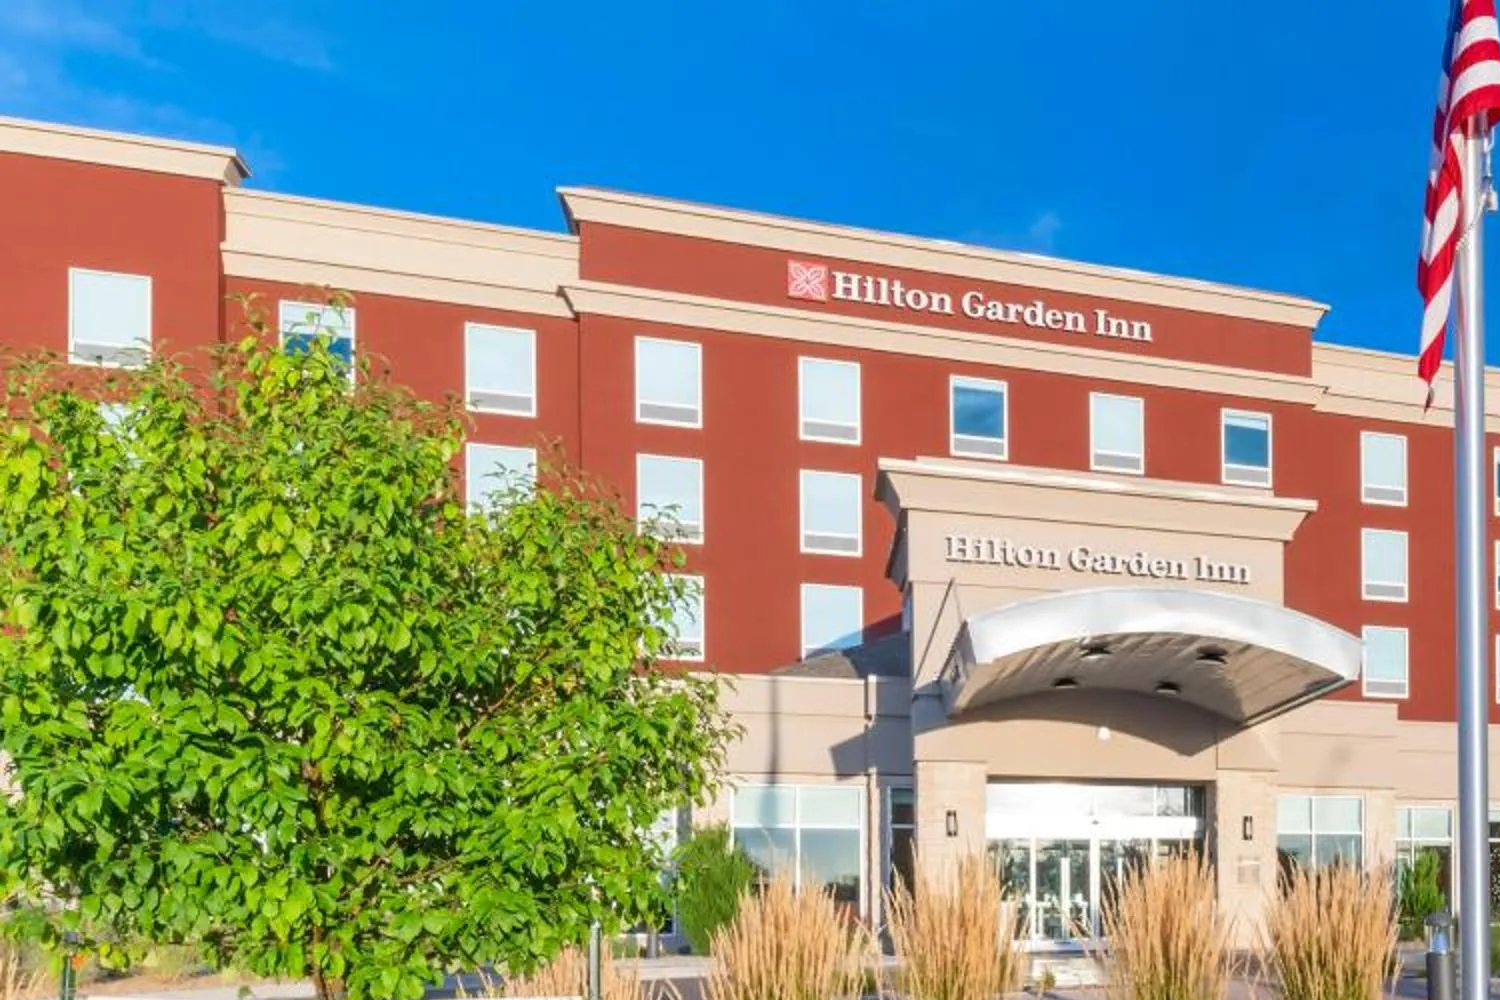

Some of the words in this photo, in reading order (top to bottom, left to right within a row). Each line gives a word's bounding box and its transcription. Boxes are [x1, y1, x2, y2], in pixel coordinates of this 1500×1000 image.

[831, 272, 953, 314] Hilton
[961, 292, 1086, 332] Garden
[1093, 309, 1153, 341] Inn
[946, 534, 1060, 570] Hilton
[1068, 546, 1187, 580] Garden
[1194, 556, 1249, 584] Inn
